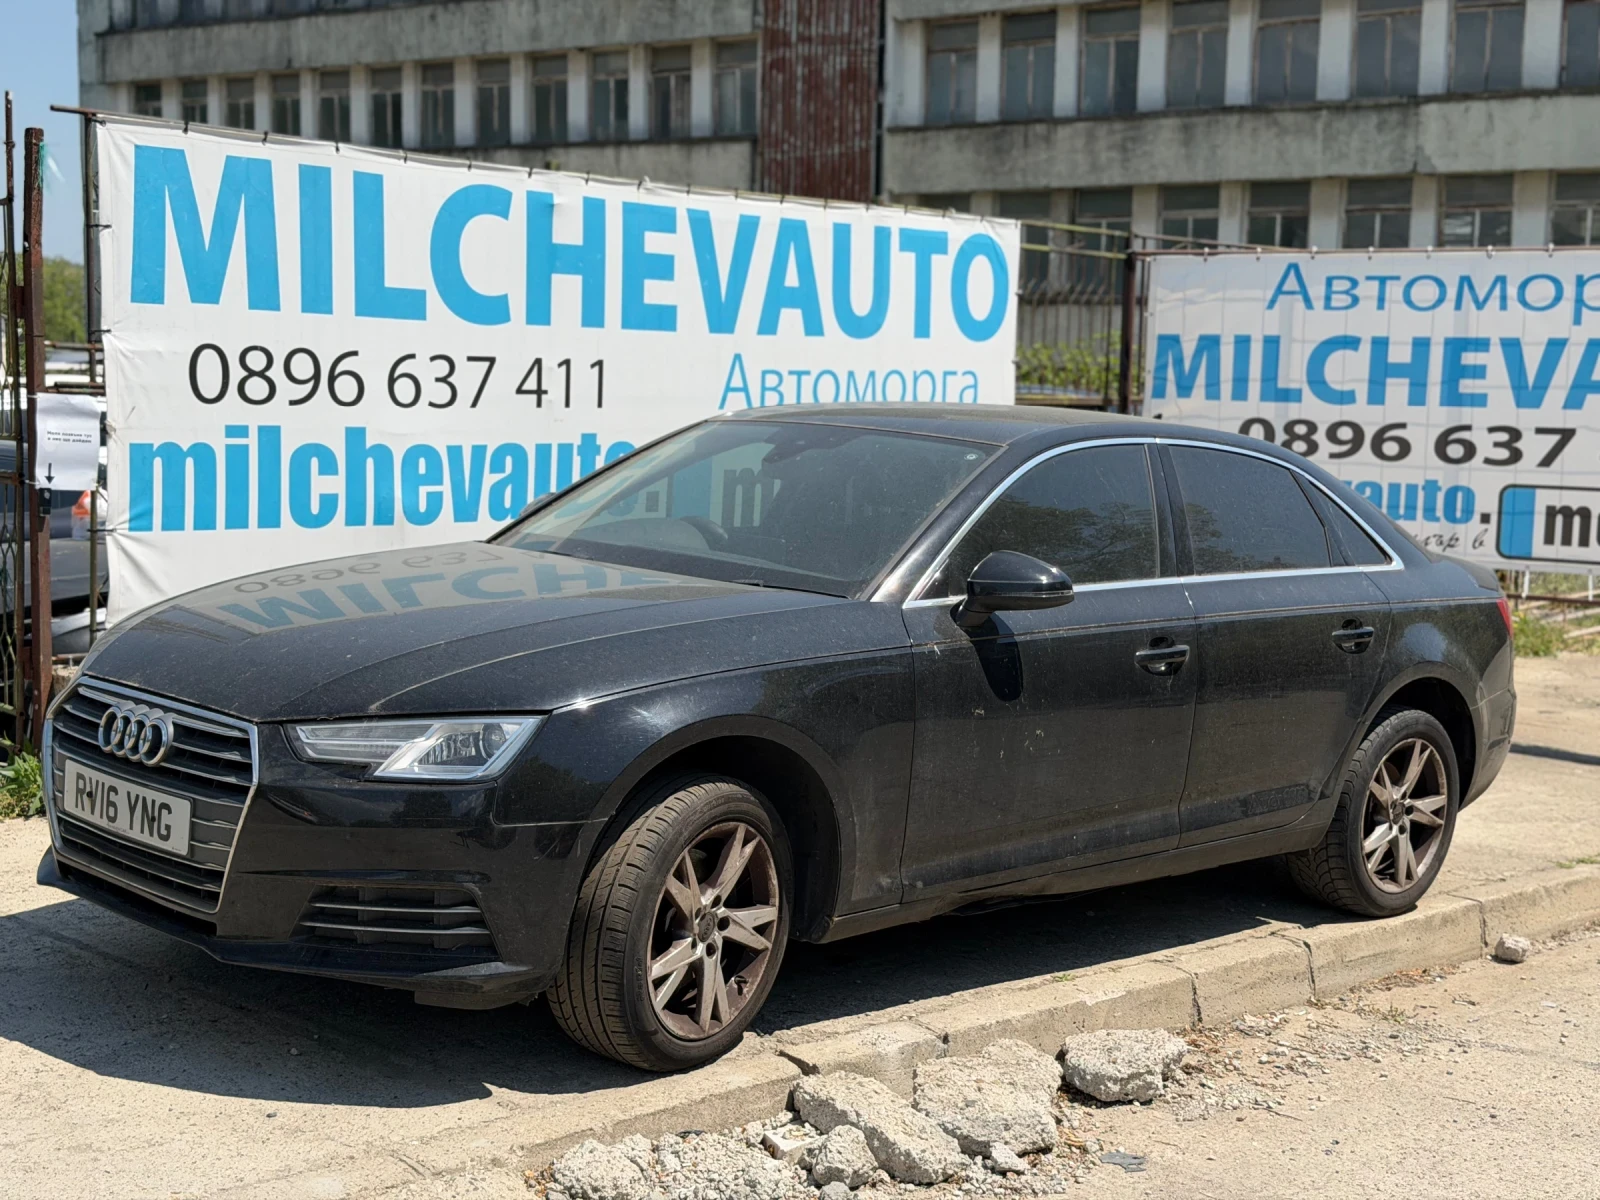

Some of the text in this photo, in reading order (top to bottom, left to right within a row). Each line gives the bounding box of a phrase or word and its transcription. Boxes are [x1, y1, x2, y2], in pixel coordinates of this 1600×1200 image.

[130, 144, 1009, 342] MILCHEVAUTO
[188, 343, 604, 409] 0896 637 411
[718, 353, 978, 410] Автоморга
[1151, 333, 1600, 411] MILCHEVA
[1238, 417, 1577, 468] 0896 637
[74, 771, 173, 842] RV16 YNG
